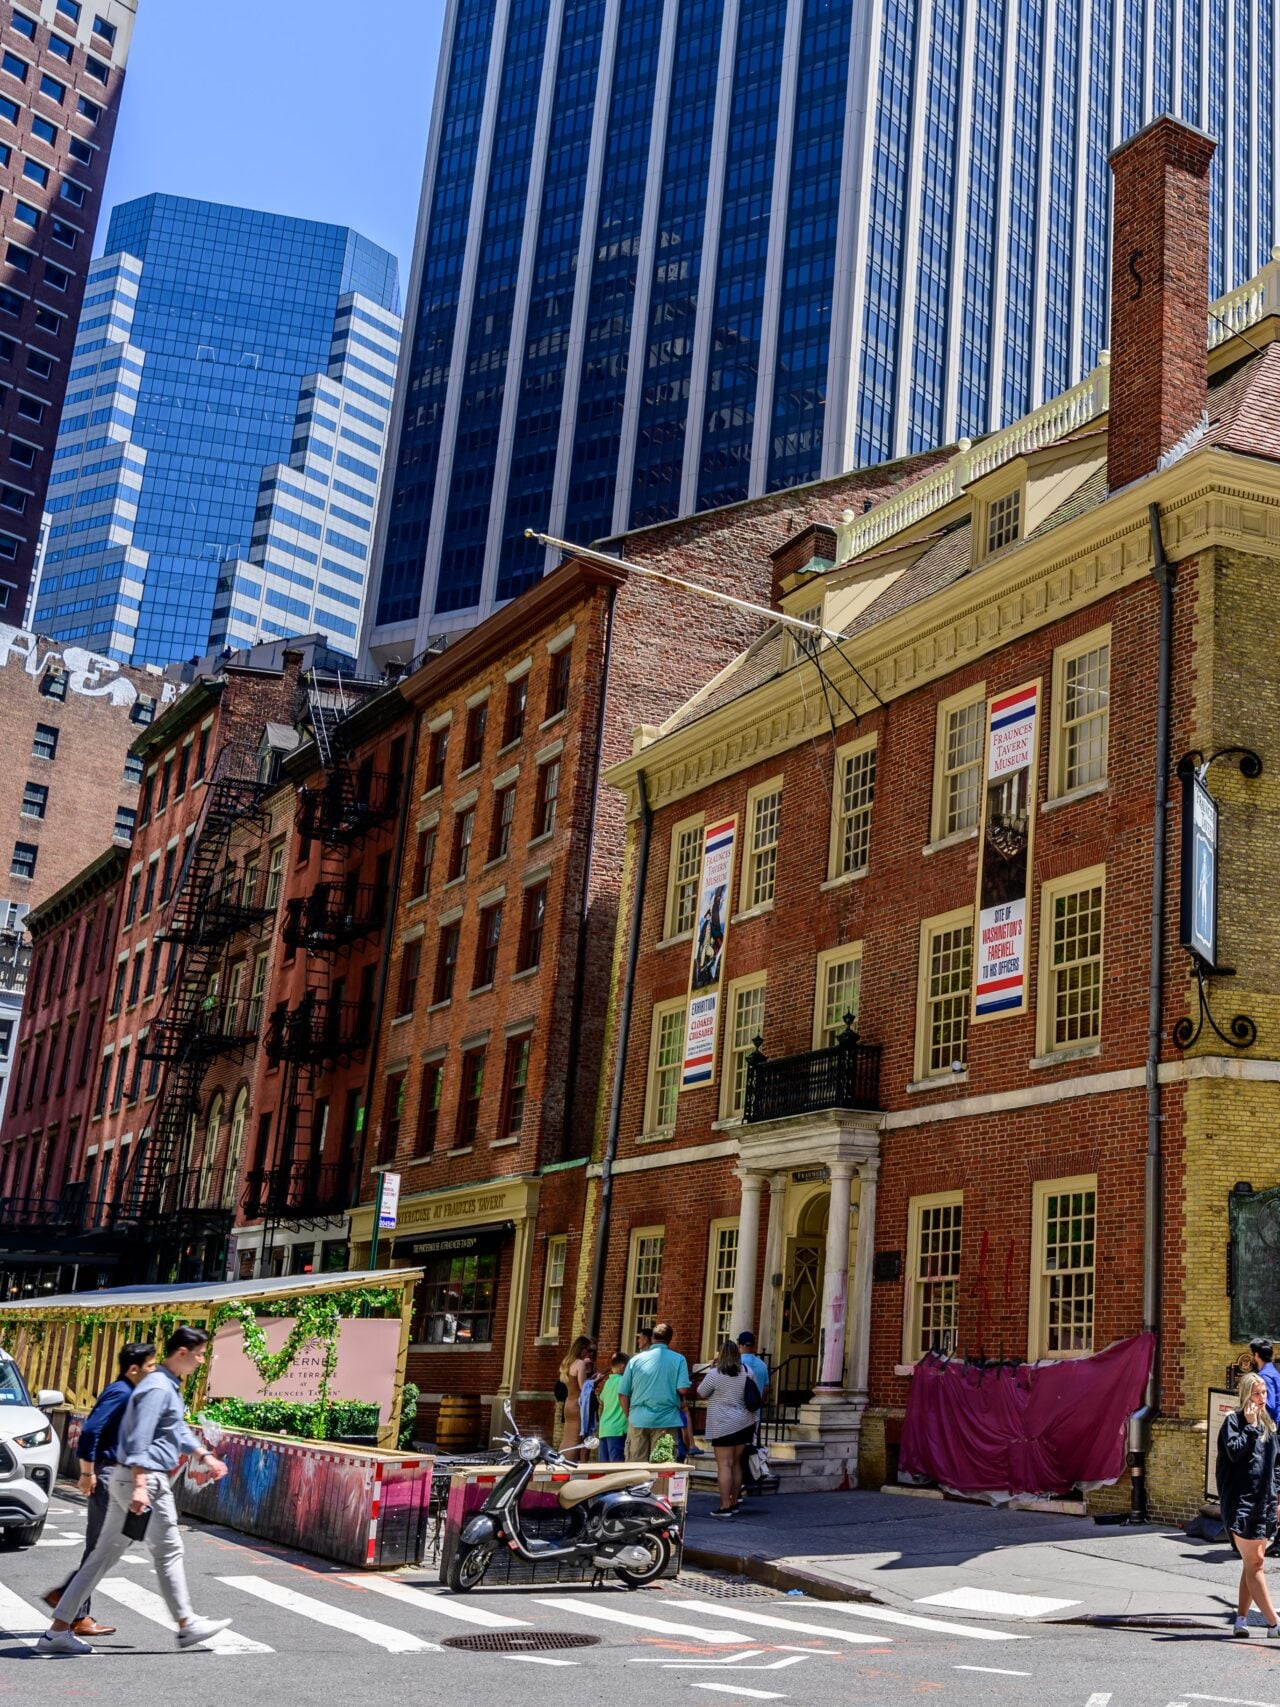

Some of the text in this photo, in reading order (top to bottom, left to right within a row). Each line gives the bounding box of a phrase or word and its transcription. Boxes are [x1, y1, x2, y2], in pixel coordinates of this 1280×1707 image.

[993, 723, 1033, 746] FRAUNCES
[997, 739, 1027, 757] TAVERN
[994, 751, 1028, 772] MUSEUM
[994, 906, 1012, 923] SITE OF
[982, 919, 1023, 945] WASHINGTON'S
[988, 940, 1015, 961] FAREWELL
[983, 965, 989, 979] TO
[998, 957, 1020, 975] OFFICERS
[691, 996, 716, 1016] EXHIBITION
[690, 1016, 714, 1030] CLOAKED
[688, 1026, 714, 1041] CRUSADER
[433, 1204, 443, 1218] AT
[443, 1199, 476, 1217] FRAUNCES
[293, 1357, 329, 1367] ERNE
